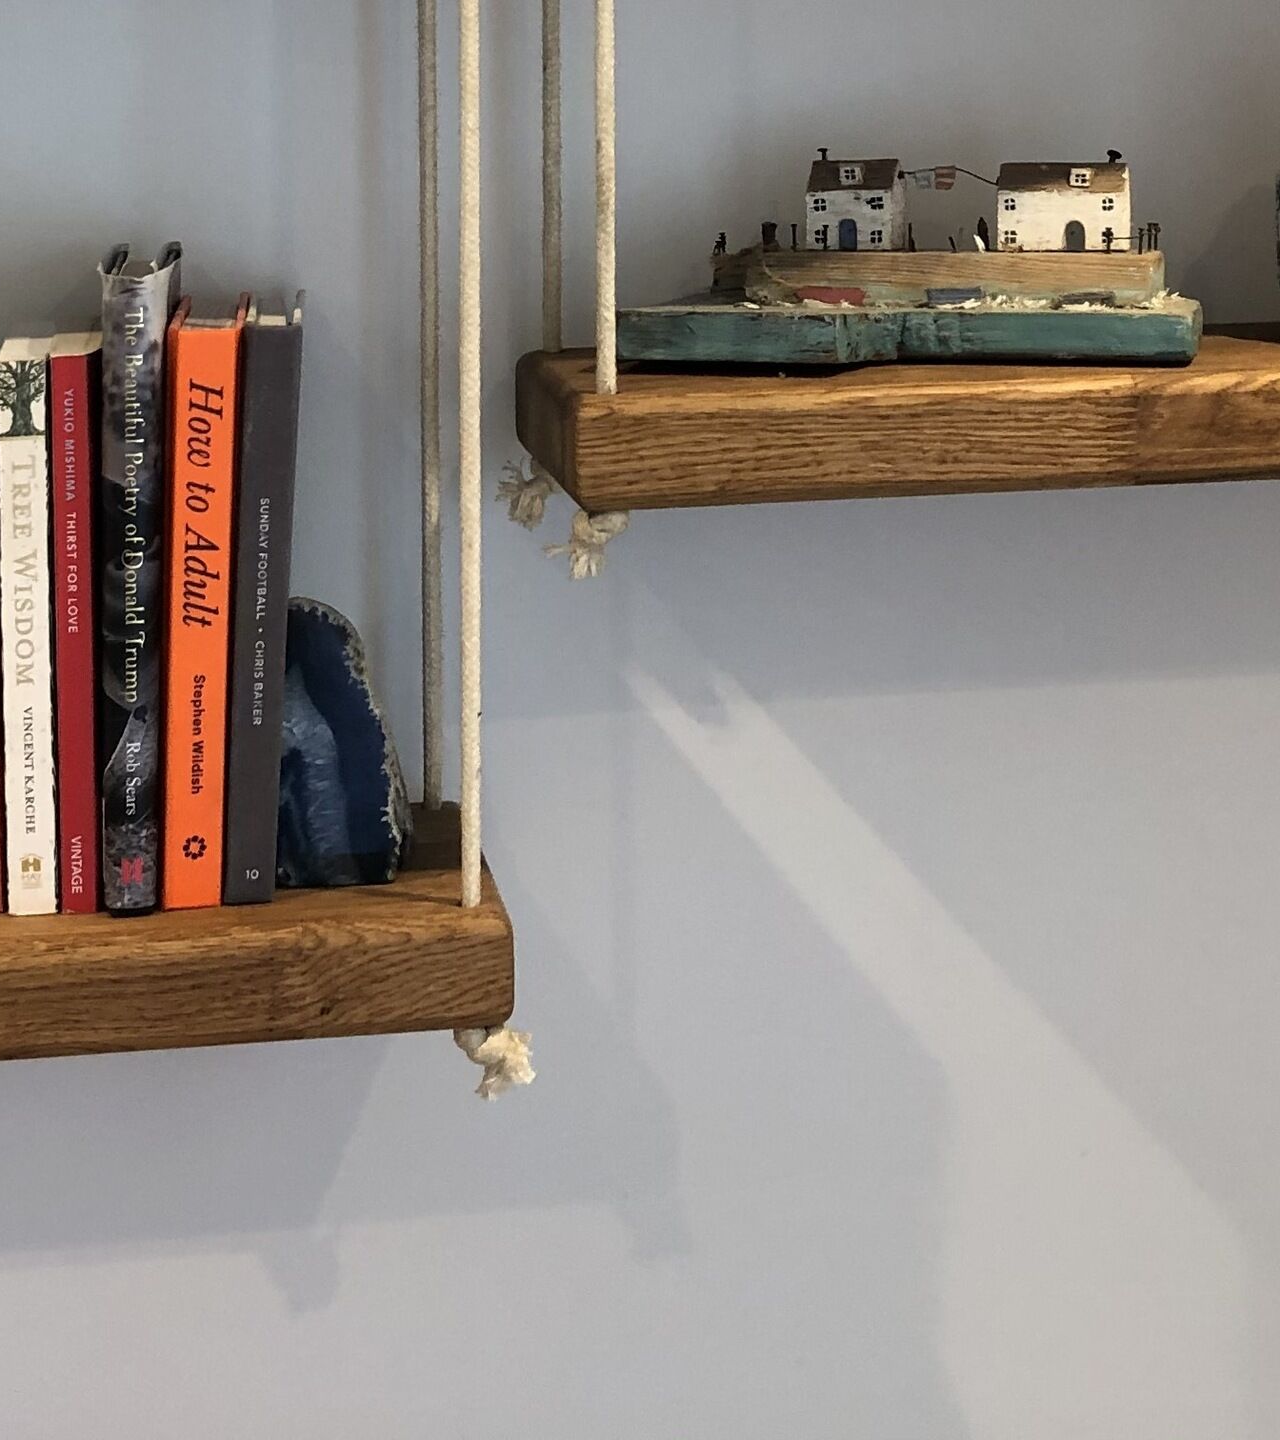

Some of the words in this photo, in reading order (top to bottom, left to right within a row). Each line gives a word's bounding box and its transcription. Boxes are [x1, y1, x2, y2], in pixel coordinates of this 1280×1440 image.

[124, 306, 144, 346] The
[63, 389, 75, 432] YUKIO
[124, 353, 144, 443] Beautiful
[187, 378, 224, 468] How
[11, 455, 36, 539] TREE
[63, 439, 76, 502] MISHIMA
[121, 451, 143, 517] Poetry
[186, 481, 215, 513] to
[65, 512, 77, 560] THIRST
[124, 523, 145, 546] of
[259, 498, 271, 548] SUNDAY
[67, 565, 78, 592] FOR
[120, 549, 145, 625] Donald
[182, 523, 220, 627] Adult
[256, 553, 268, 620] FOOTBALL
[13, 549, 39, 686] WISDOM
[67, 598, 78, 634] LOVE
[124, 631, 146, 704] Trump
[255, 640, 266, 678] CHRIS
[190, 674, 206, 737] Stephen
[253, 682, 264, 726] BAKER
[23, 706, 34, 770] VINCENT
[126, 742, 141, 773] Rob
[191, 739, 204, 795] Wildish
[25, 773, 36, 834] KARCHE
[125, 776, 142, 816] Sears
[70, 836, 82, 893] VINTAGE
[245, 869, 260, 880] 10
